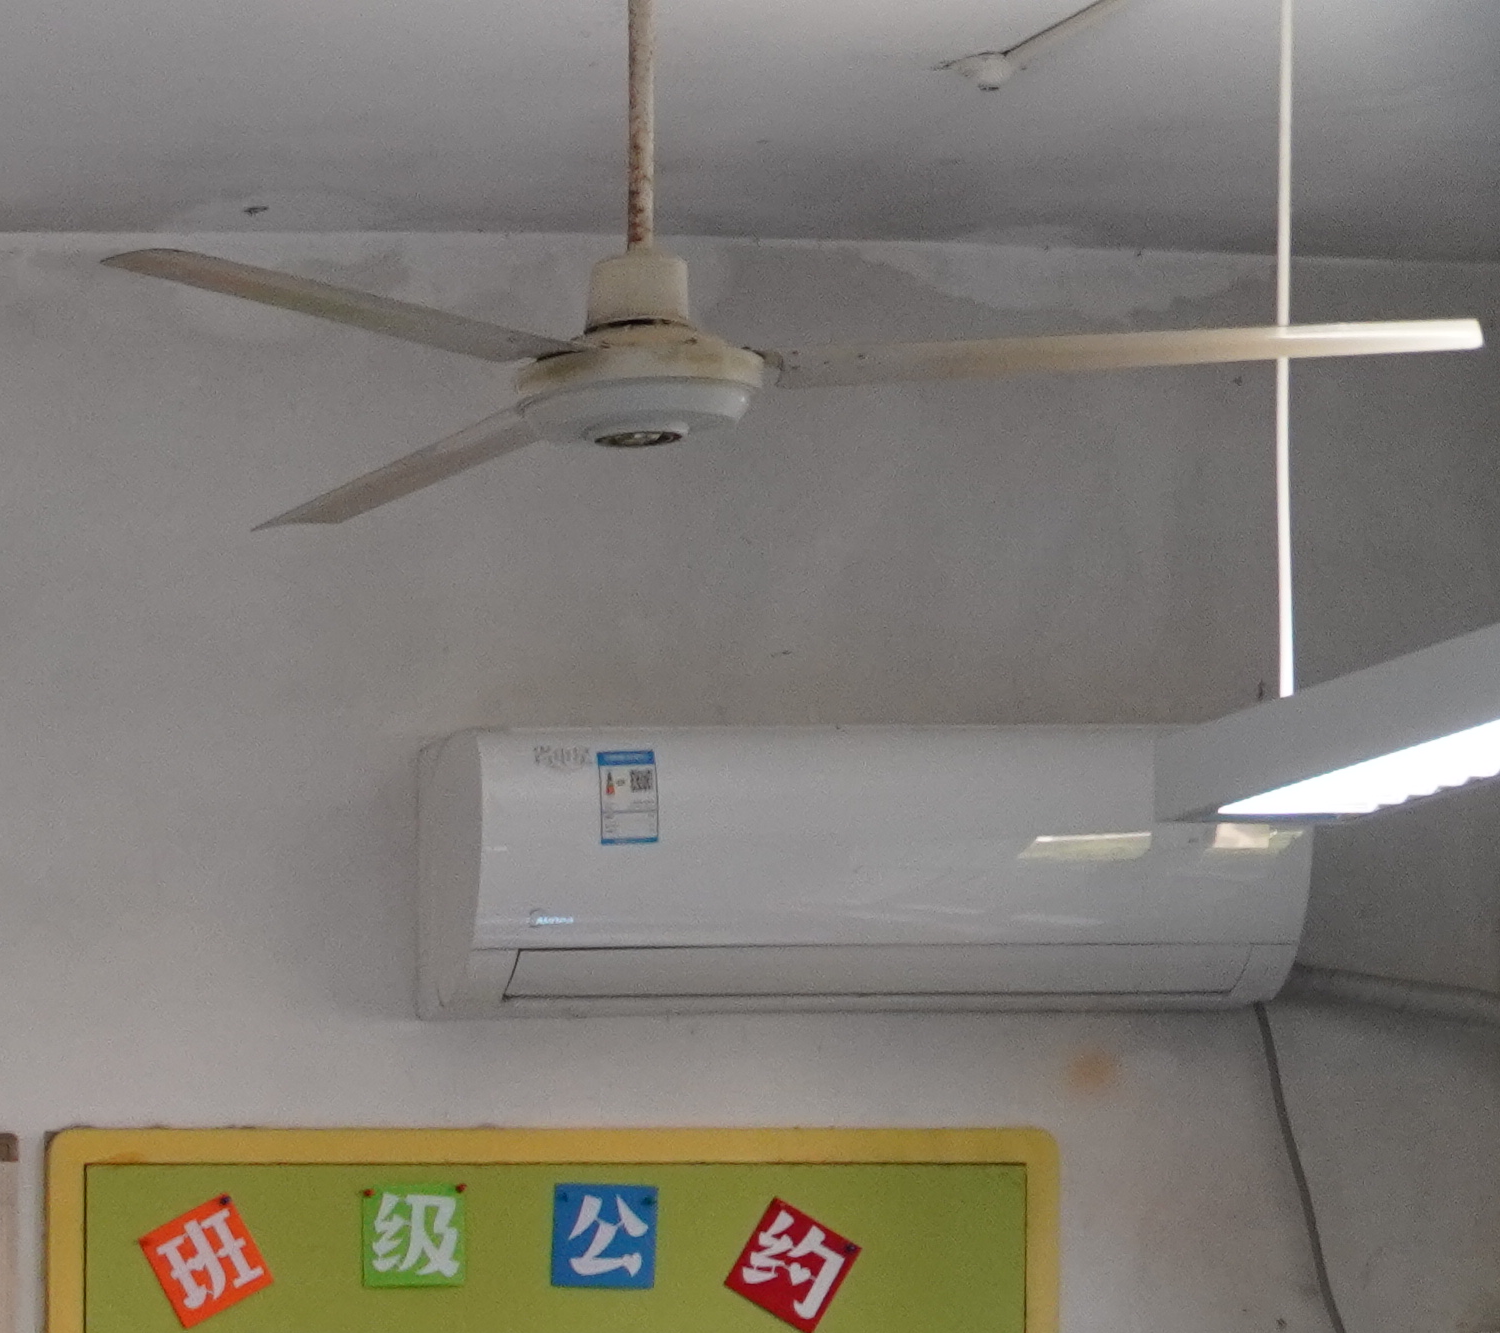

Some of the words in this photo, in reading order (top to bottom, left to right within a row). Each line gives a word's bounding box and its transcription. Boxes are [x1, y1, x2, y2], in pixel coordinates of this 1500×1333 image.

[157, 1209, 263, 1311] 班
[372, 1193, 460, 1280] 级
[567, 1196, 648, 1278] 公
[741, 1210, 845, 1320] 约
